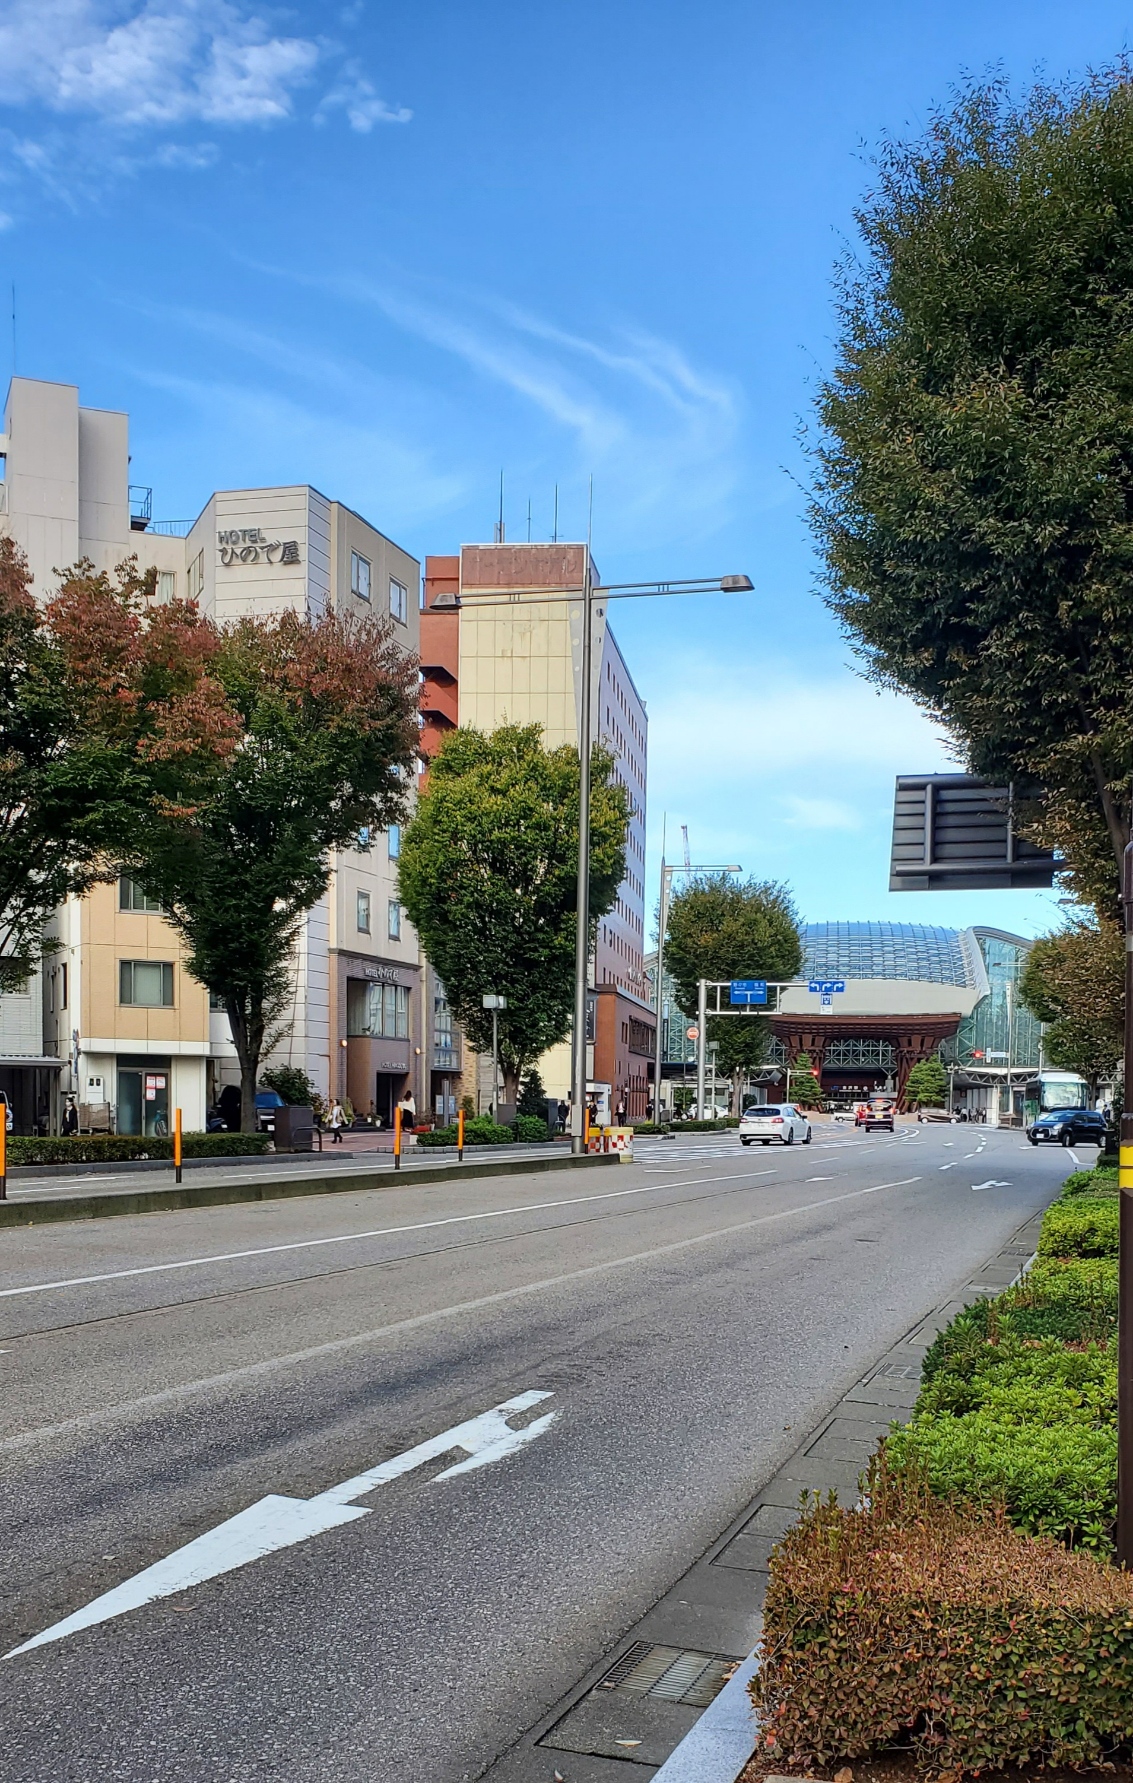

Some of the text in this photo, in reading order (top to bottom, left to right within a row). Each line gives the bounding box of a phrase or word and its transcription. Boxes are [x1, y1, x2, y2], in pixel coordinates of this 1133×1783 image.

[218, 528, 267, 545] HOTEL
[218, 540, 301, 565] ひので屋
